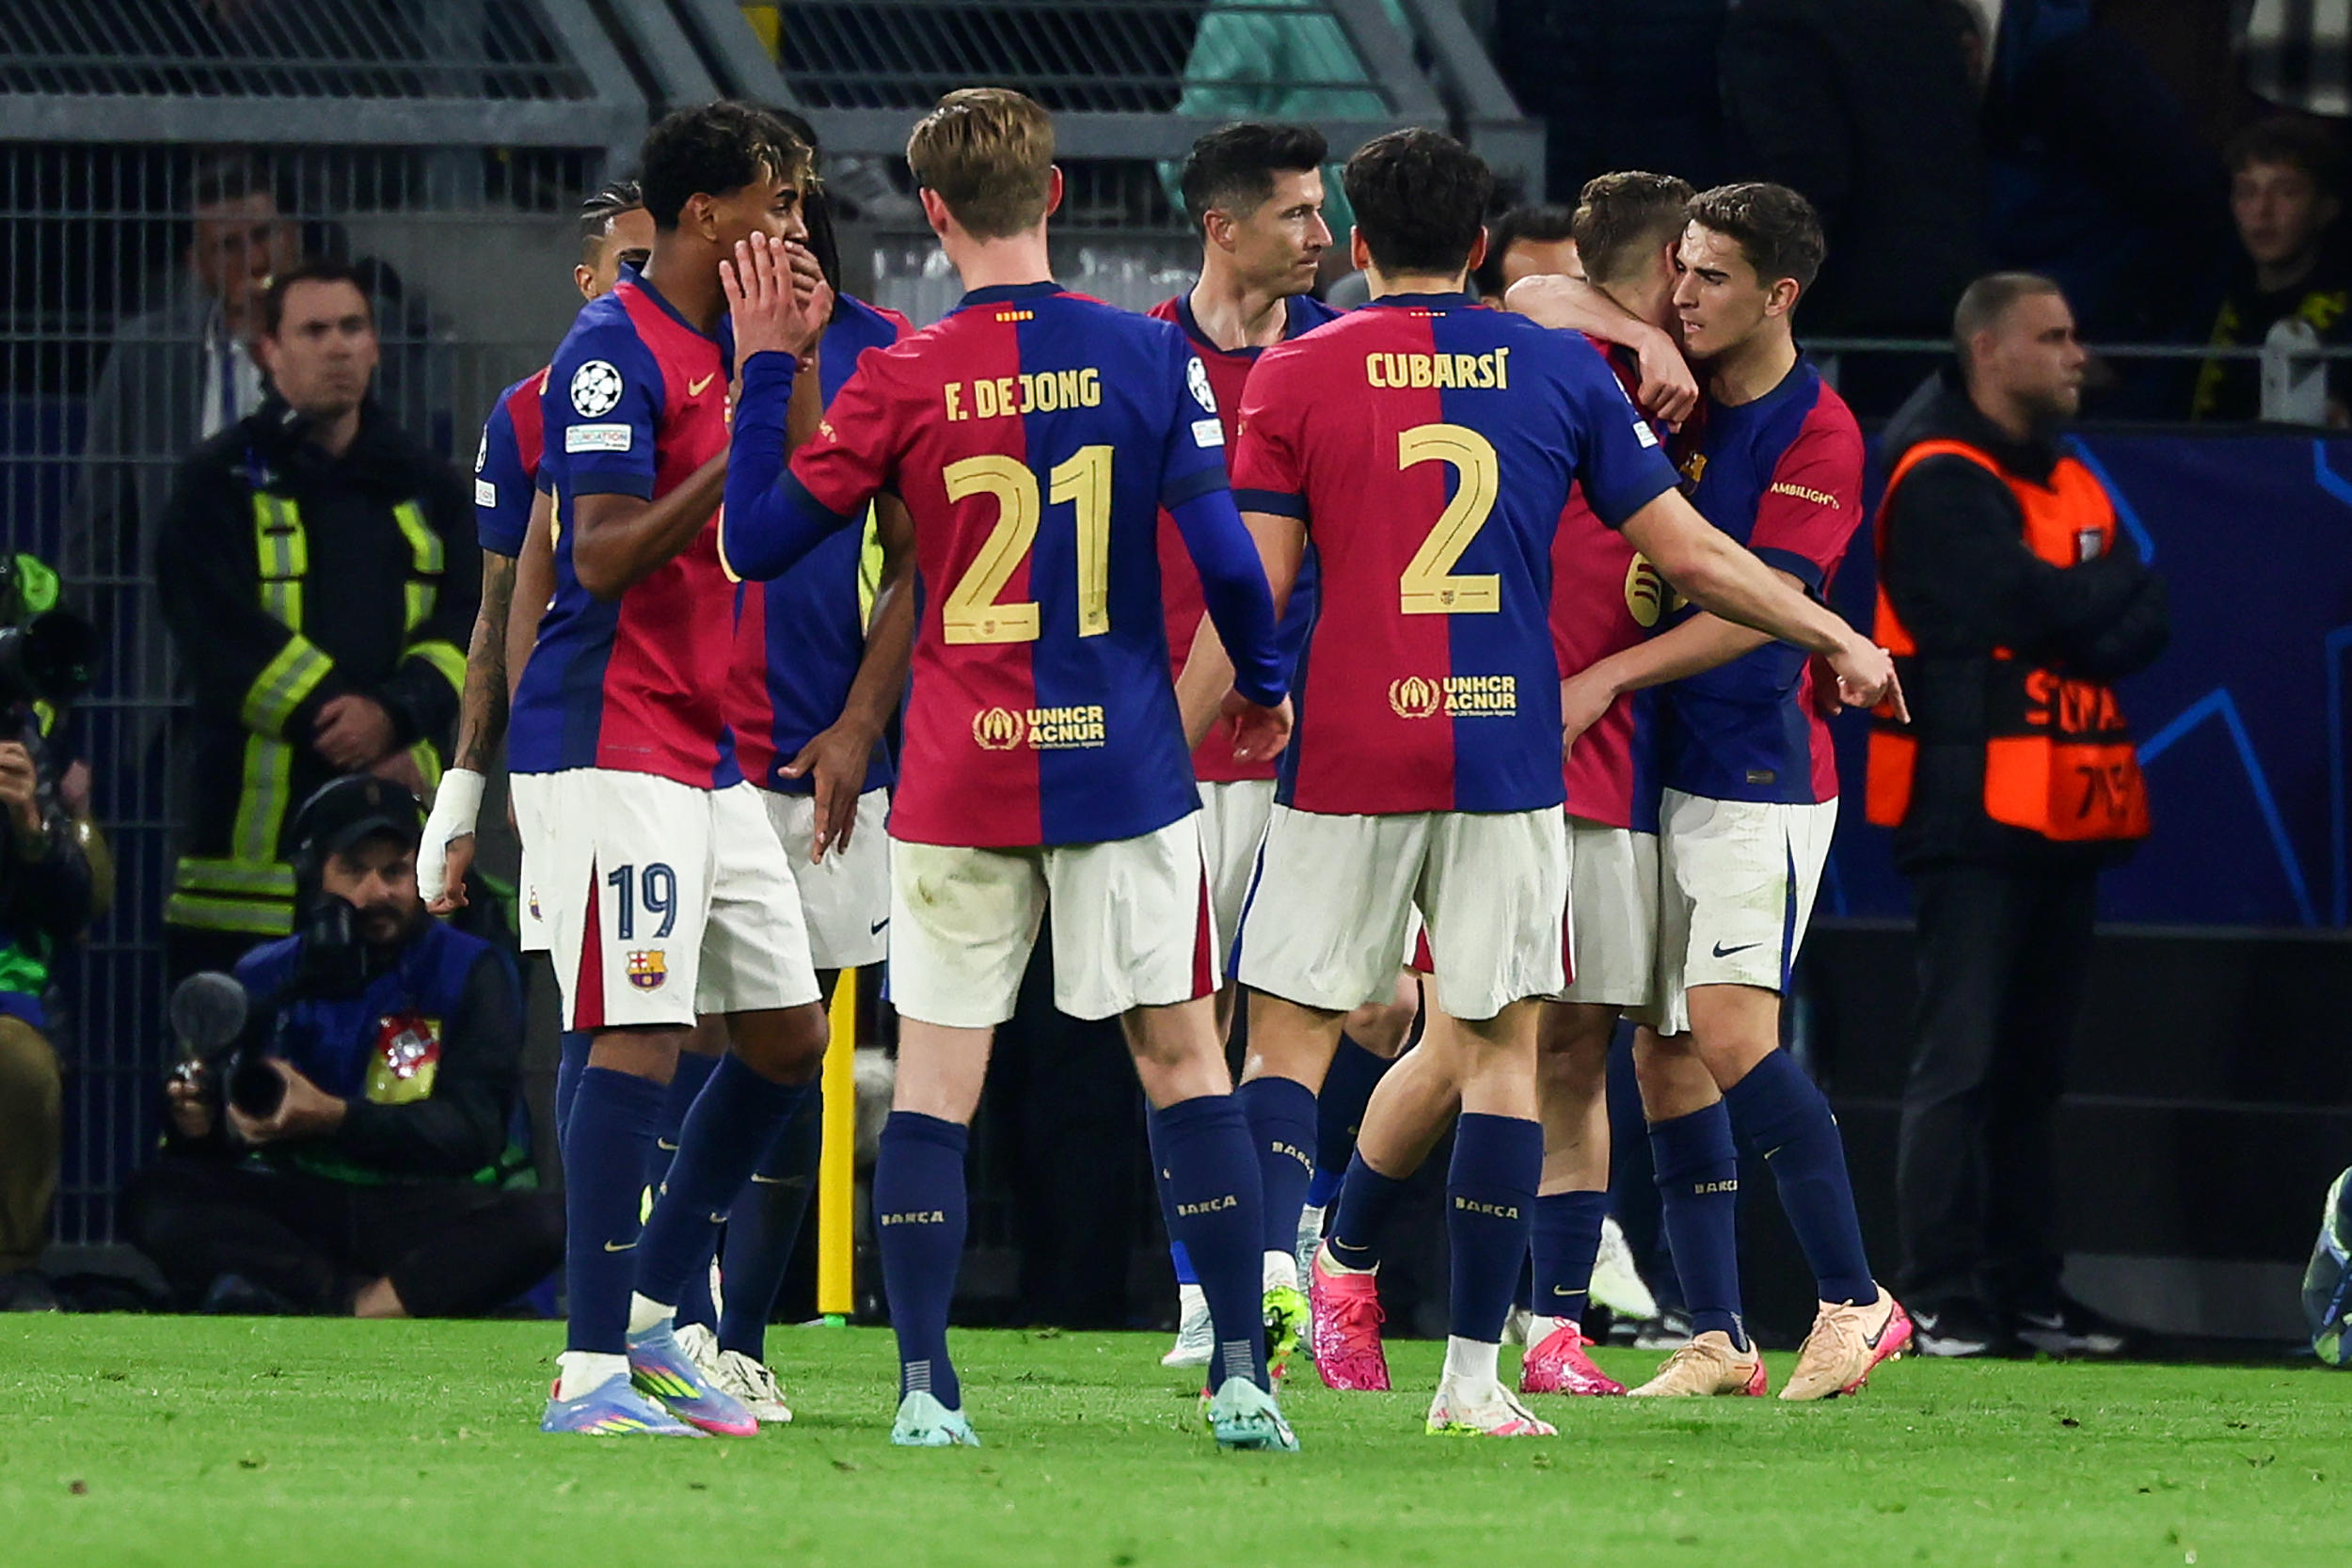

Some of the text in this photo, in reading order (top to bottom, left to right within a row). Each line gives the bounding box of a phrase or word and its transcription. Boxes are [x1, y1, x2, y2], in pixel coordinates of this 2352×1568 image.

[1366, 347, 1509, 389] CUBARSÍ
[945, 382, 969, 420] F.
[1398, 423, 1500, 614] 2
[943, 445, 1114, 644] 21
[1442, 676, 1516, 693] UNHCR
[1443, 693, 1517, 709] ACNUR
[1026, 705, 1104, 725] UNHCR
[1027, 723, 1104, 742] ACNUR
[608, 863, 677, 941] 19
